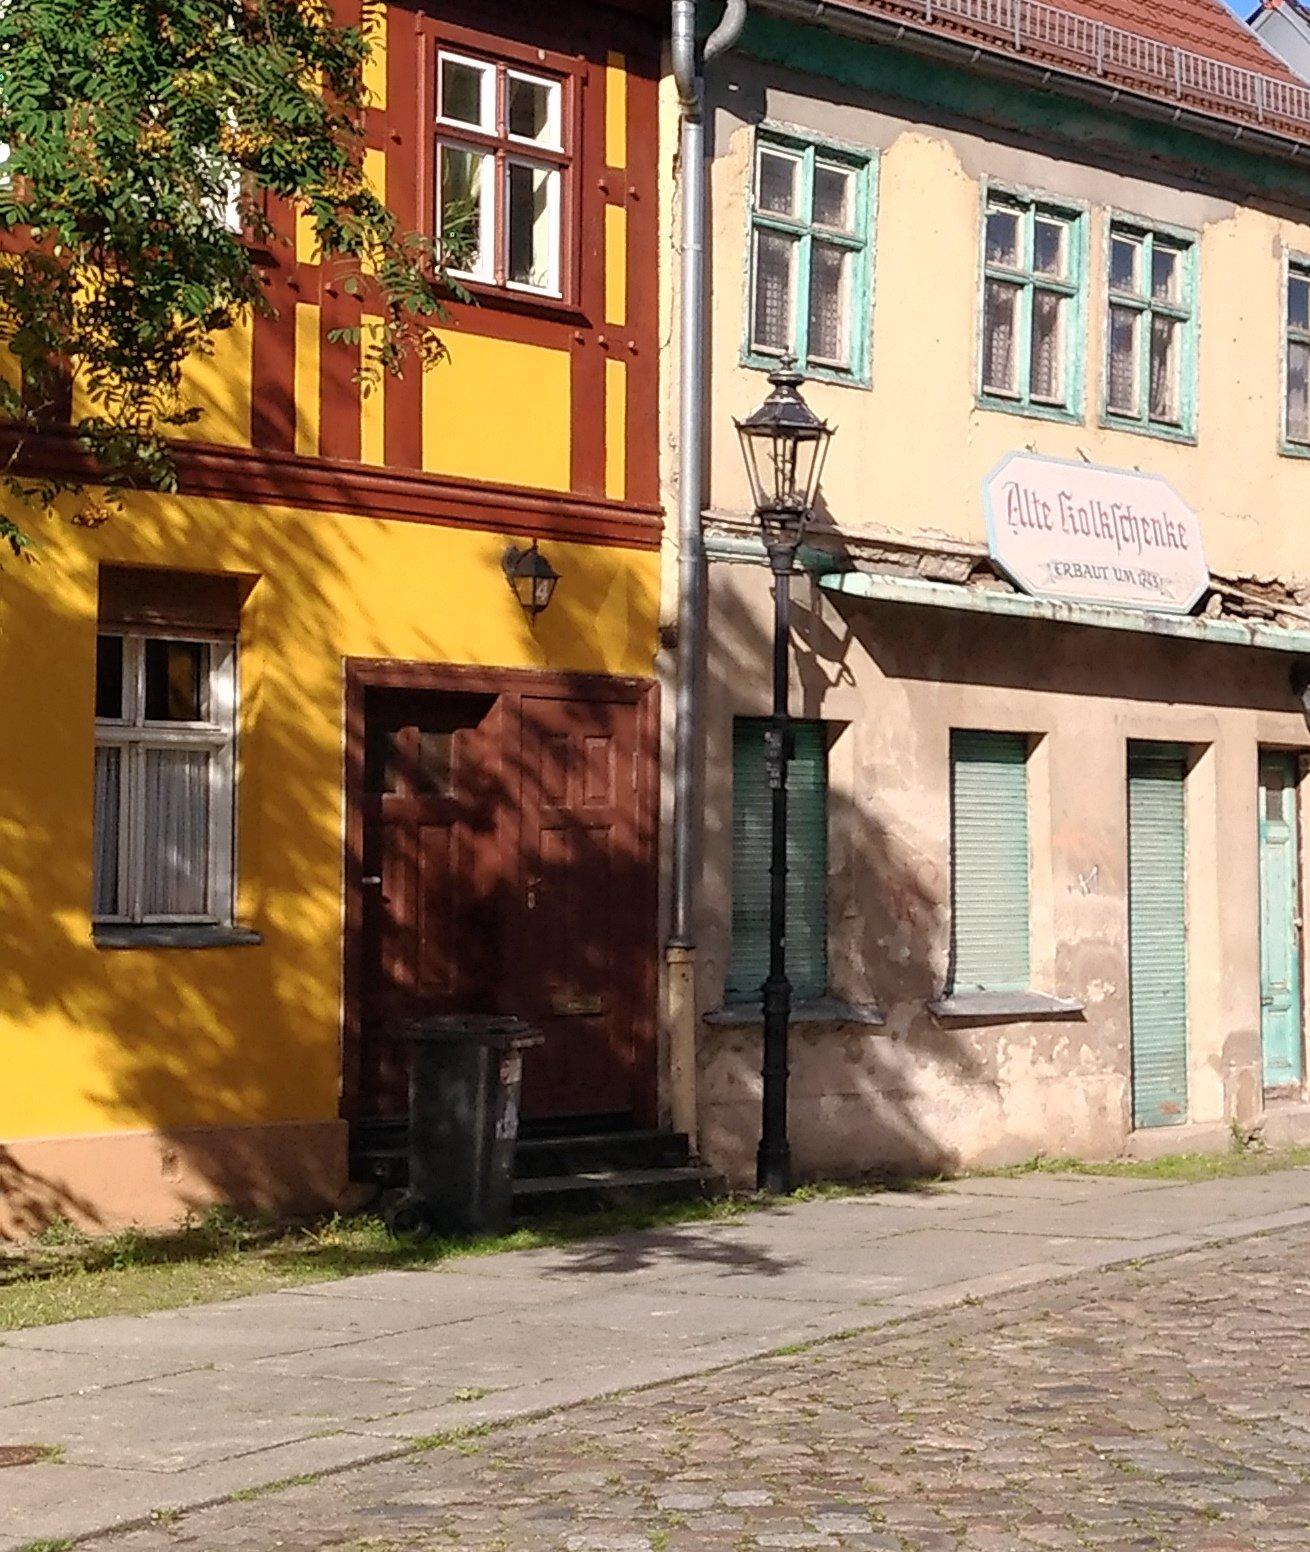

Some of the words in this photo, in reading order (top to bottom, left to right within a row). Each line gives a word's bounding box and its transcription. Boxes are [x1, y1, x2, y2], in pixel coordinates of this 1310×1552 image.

[1002, 481, 1053, 535] Alte
[1053, 561, 1109, 580] ERBAUT
[535, 578, 548, 601] 4
